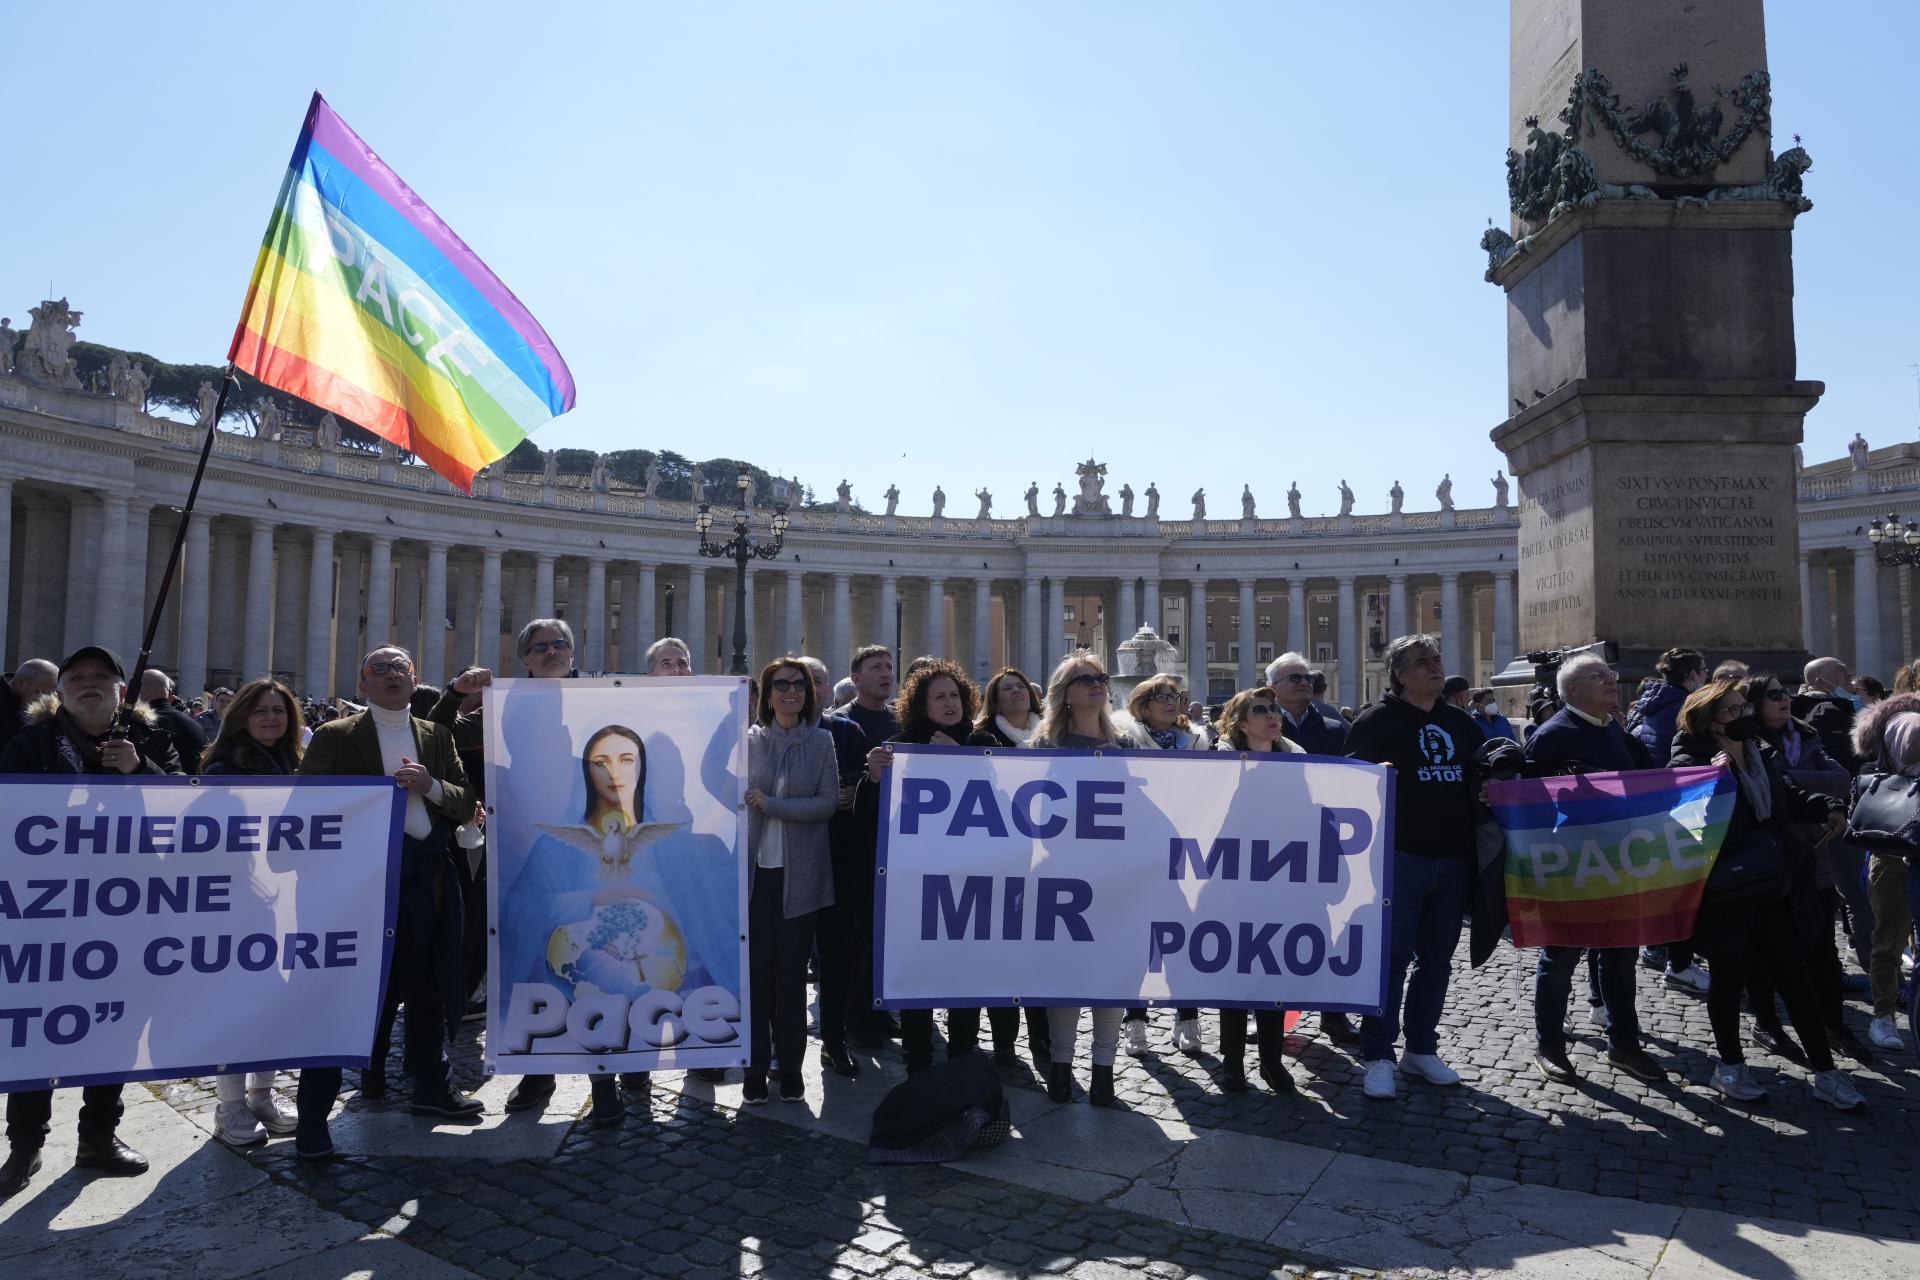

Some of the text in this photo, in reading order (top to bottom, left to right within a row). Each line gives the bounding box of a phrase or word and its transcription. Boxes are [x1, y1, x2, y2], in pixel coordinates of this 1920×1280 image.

[308, 214, 489, 390] PACE
[14, 814, 343, 856] CHIEDERE
[899, 777, 1126, 841] PACE
[1529, 819, 1707, 890] PACE
[920, 874, 1095, 942] MIR
[0, 931, 358, 984] MIO CUORE
[1149, 920, 1364, 977] POKOJ
[502, 983, 741, 1053] Pace
